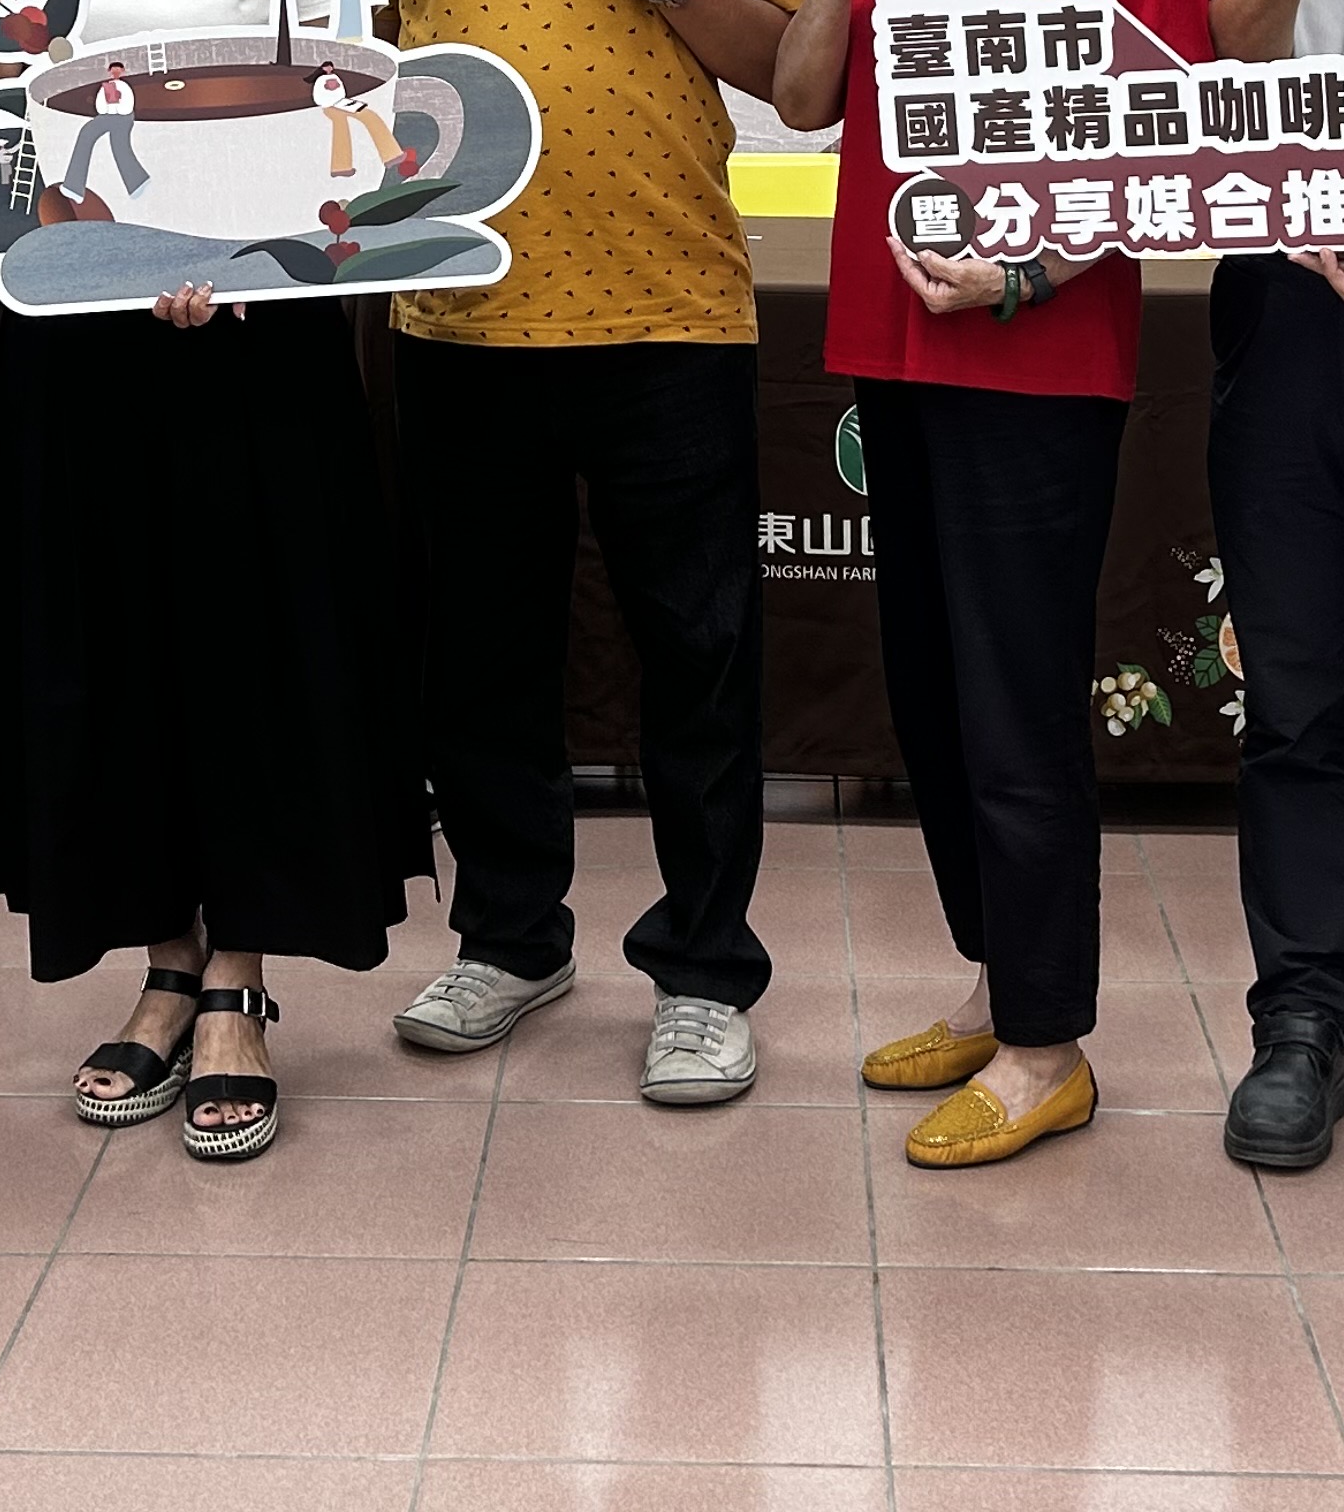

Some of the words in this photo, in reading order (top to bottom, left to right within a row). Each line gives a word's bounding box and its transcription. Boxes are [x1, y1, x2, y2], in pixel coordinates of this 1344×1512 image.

[888, 4, 1106, 80] 臺南市
[758, 512, 875, 556] 東山
